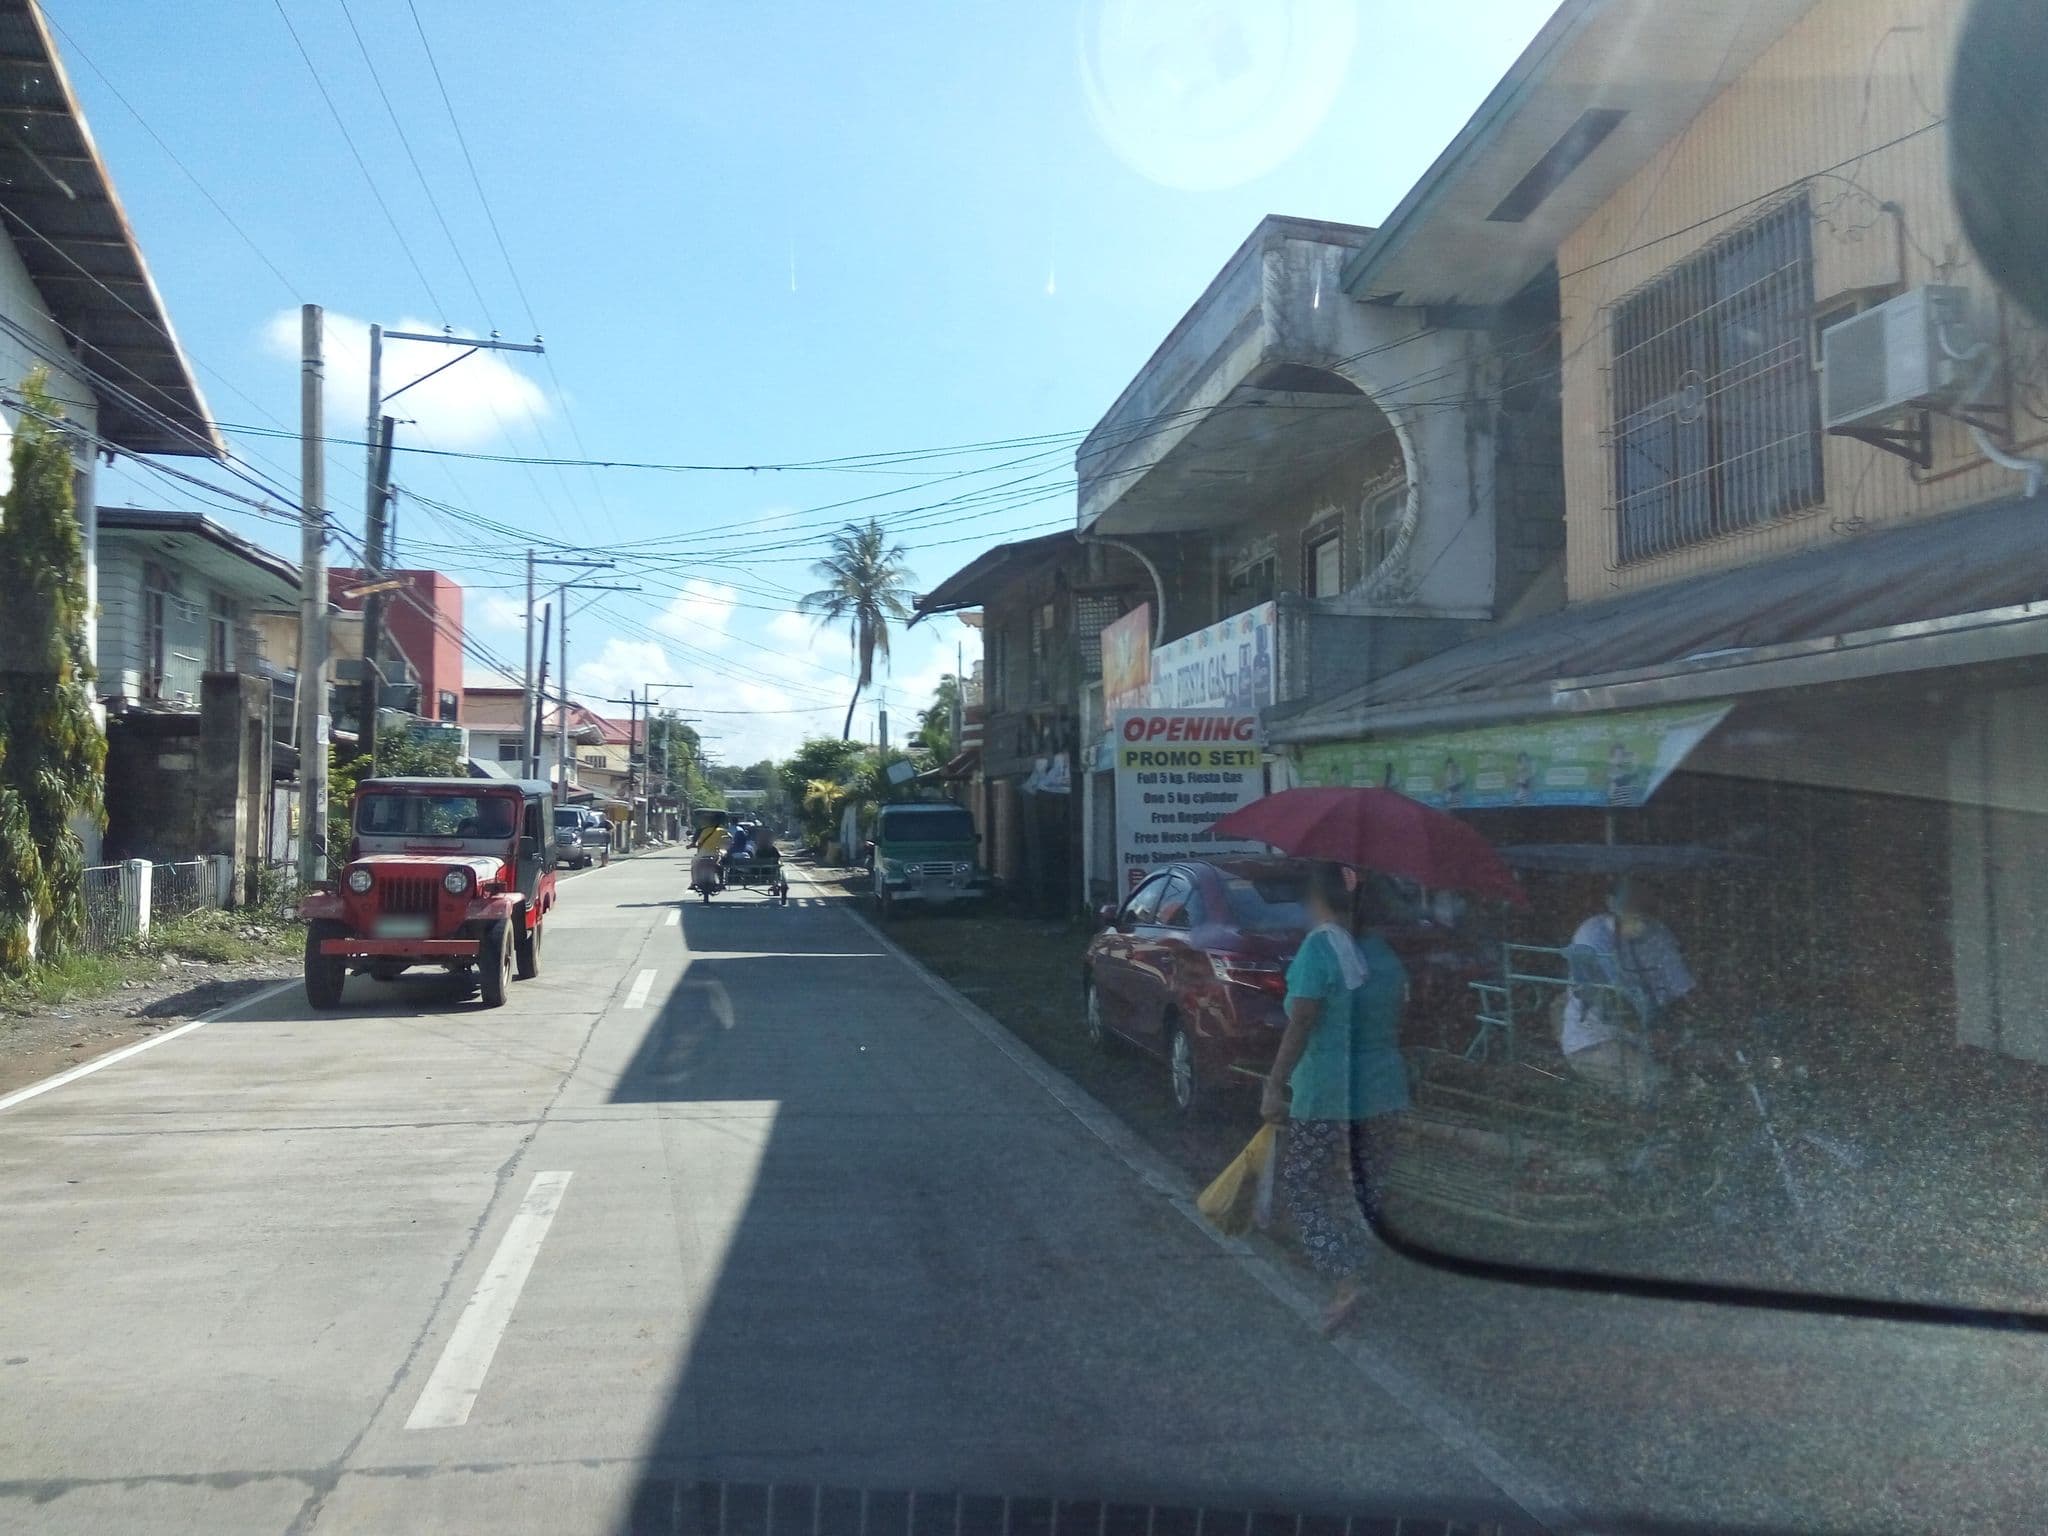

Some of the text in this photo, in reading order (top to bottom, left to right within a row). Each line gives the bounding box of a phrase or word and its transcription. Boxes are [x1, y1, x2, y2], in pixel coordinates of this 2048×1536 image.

[1123, 716, 1255, 742] OPENING
[1126, 750, 1255, 766] PROMO SET!
[1137, 772, 1157, 784] Full
[1159, 772, 1168, 784] 5
[1188, 772, 1221, 784] Fiesta
[1222, 772, 1244, 783] Gas
[1143, 792, 1165, 803] One
[1167, 792, 1175, 803] 5
[1192, 792, 1239, 804] cylinder
[1151, 812, 1175, 823] Free
[1134, 832, 1159, 843] Free
[1161, 832, 1189, 843] Hose
[1123, 852, 1150, 864] Free
